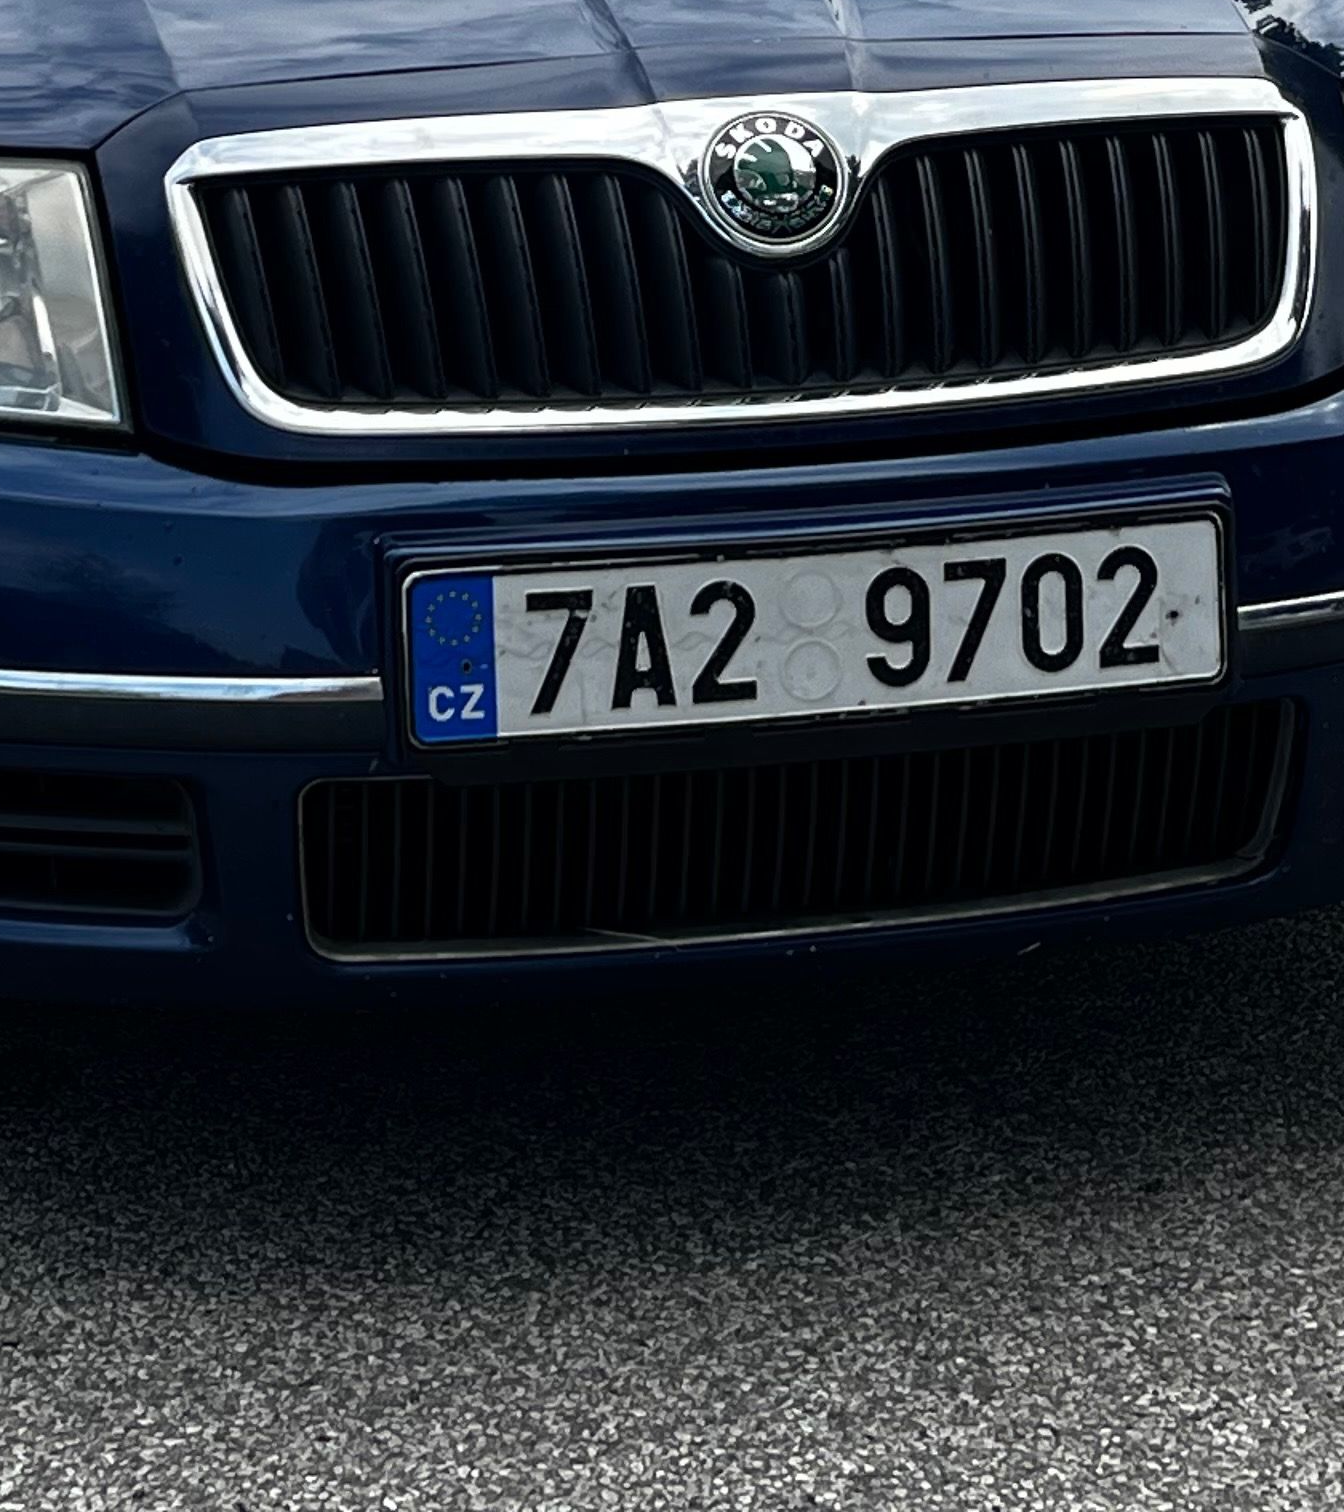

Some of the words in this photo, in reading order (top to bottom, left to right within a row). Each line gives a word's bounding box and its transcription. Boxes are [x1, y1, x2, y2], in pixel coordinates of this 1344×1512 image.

[525, 579, 758, 716] 7A2
[864, 545, 1160, 688] 9702
[427, 683, 486, 722] CZ
